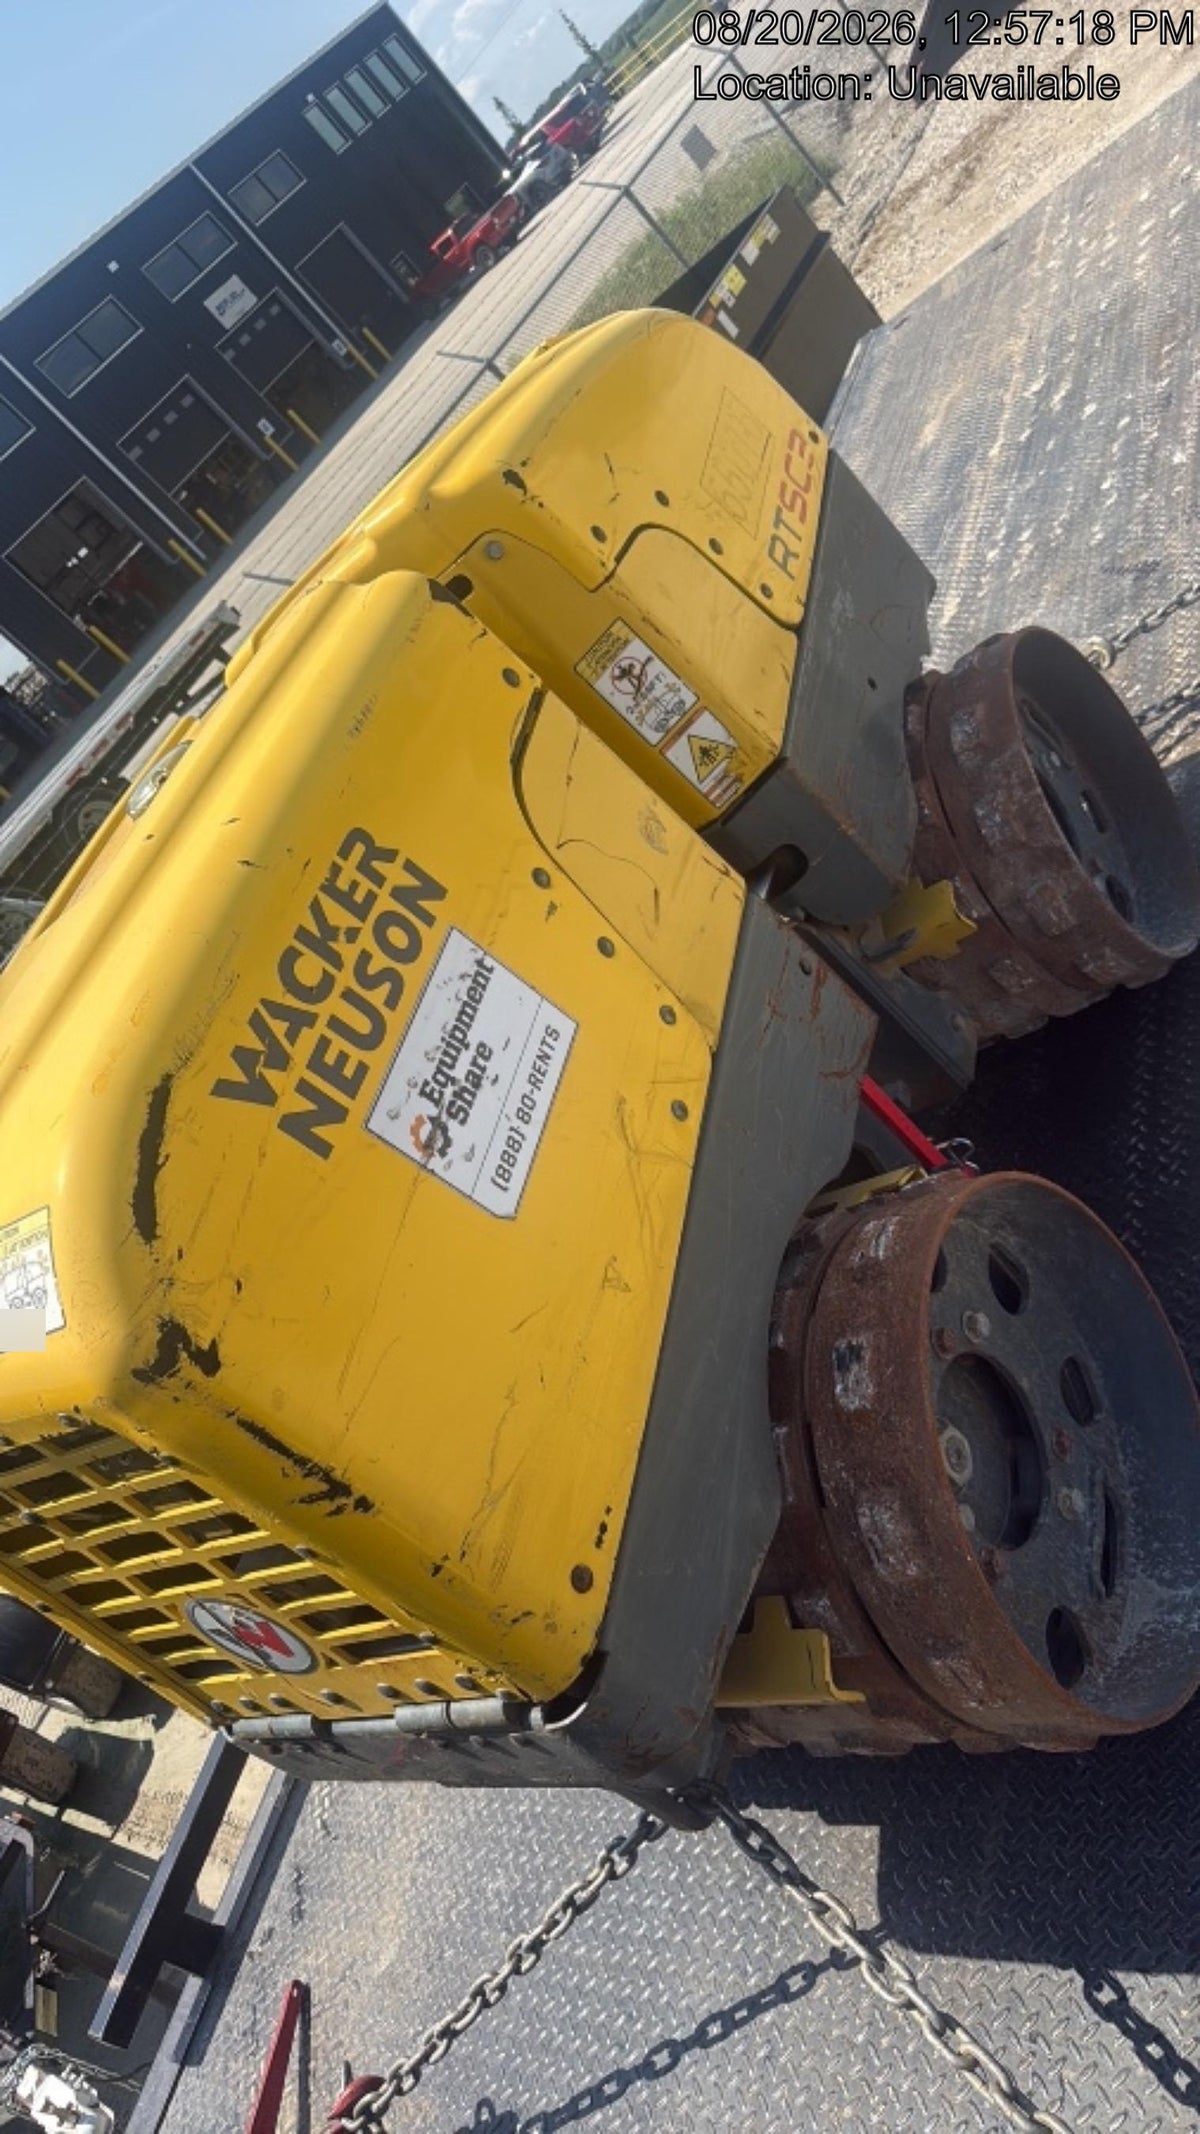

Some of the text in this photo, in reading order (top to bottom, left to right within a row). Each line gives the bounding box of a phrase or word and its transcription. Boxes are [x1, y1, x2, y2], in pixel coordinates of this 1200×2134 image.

[209, 826, 400, 1108] WACKER
[277, 857, 448, 1161] NEUSON
[418, 954, 495, 1109] Equipment
[446, 1040, 494, 1127] Share
[490, 1023, 561, 1192] (888) 80-RENTS
